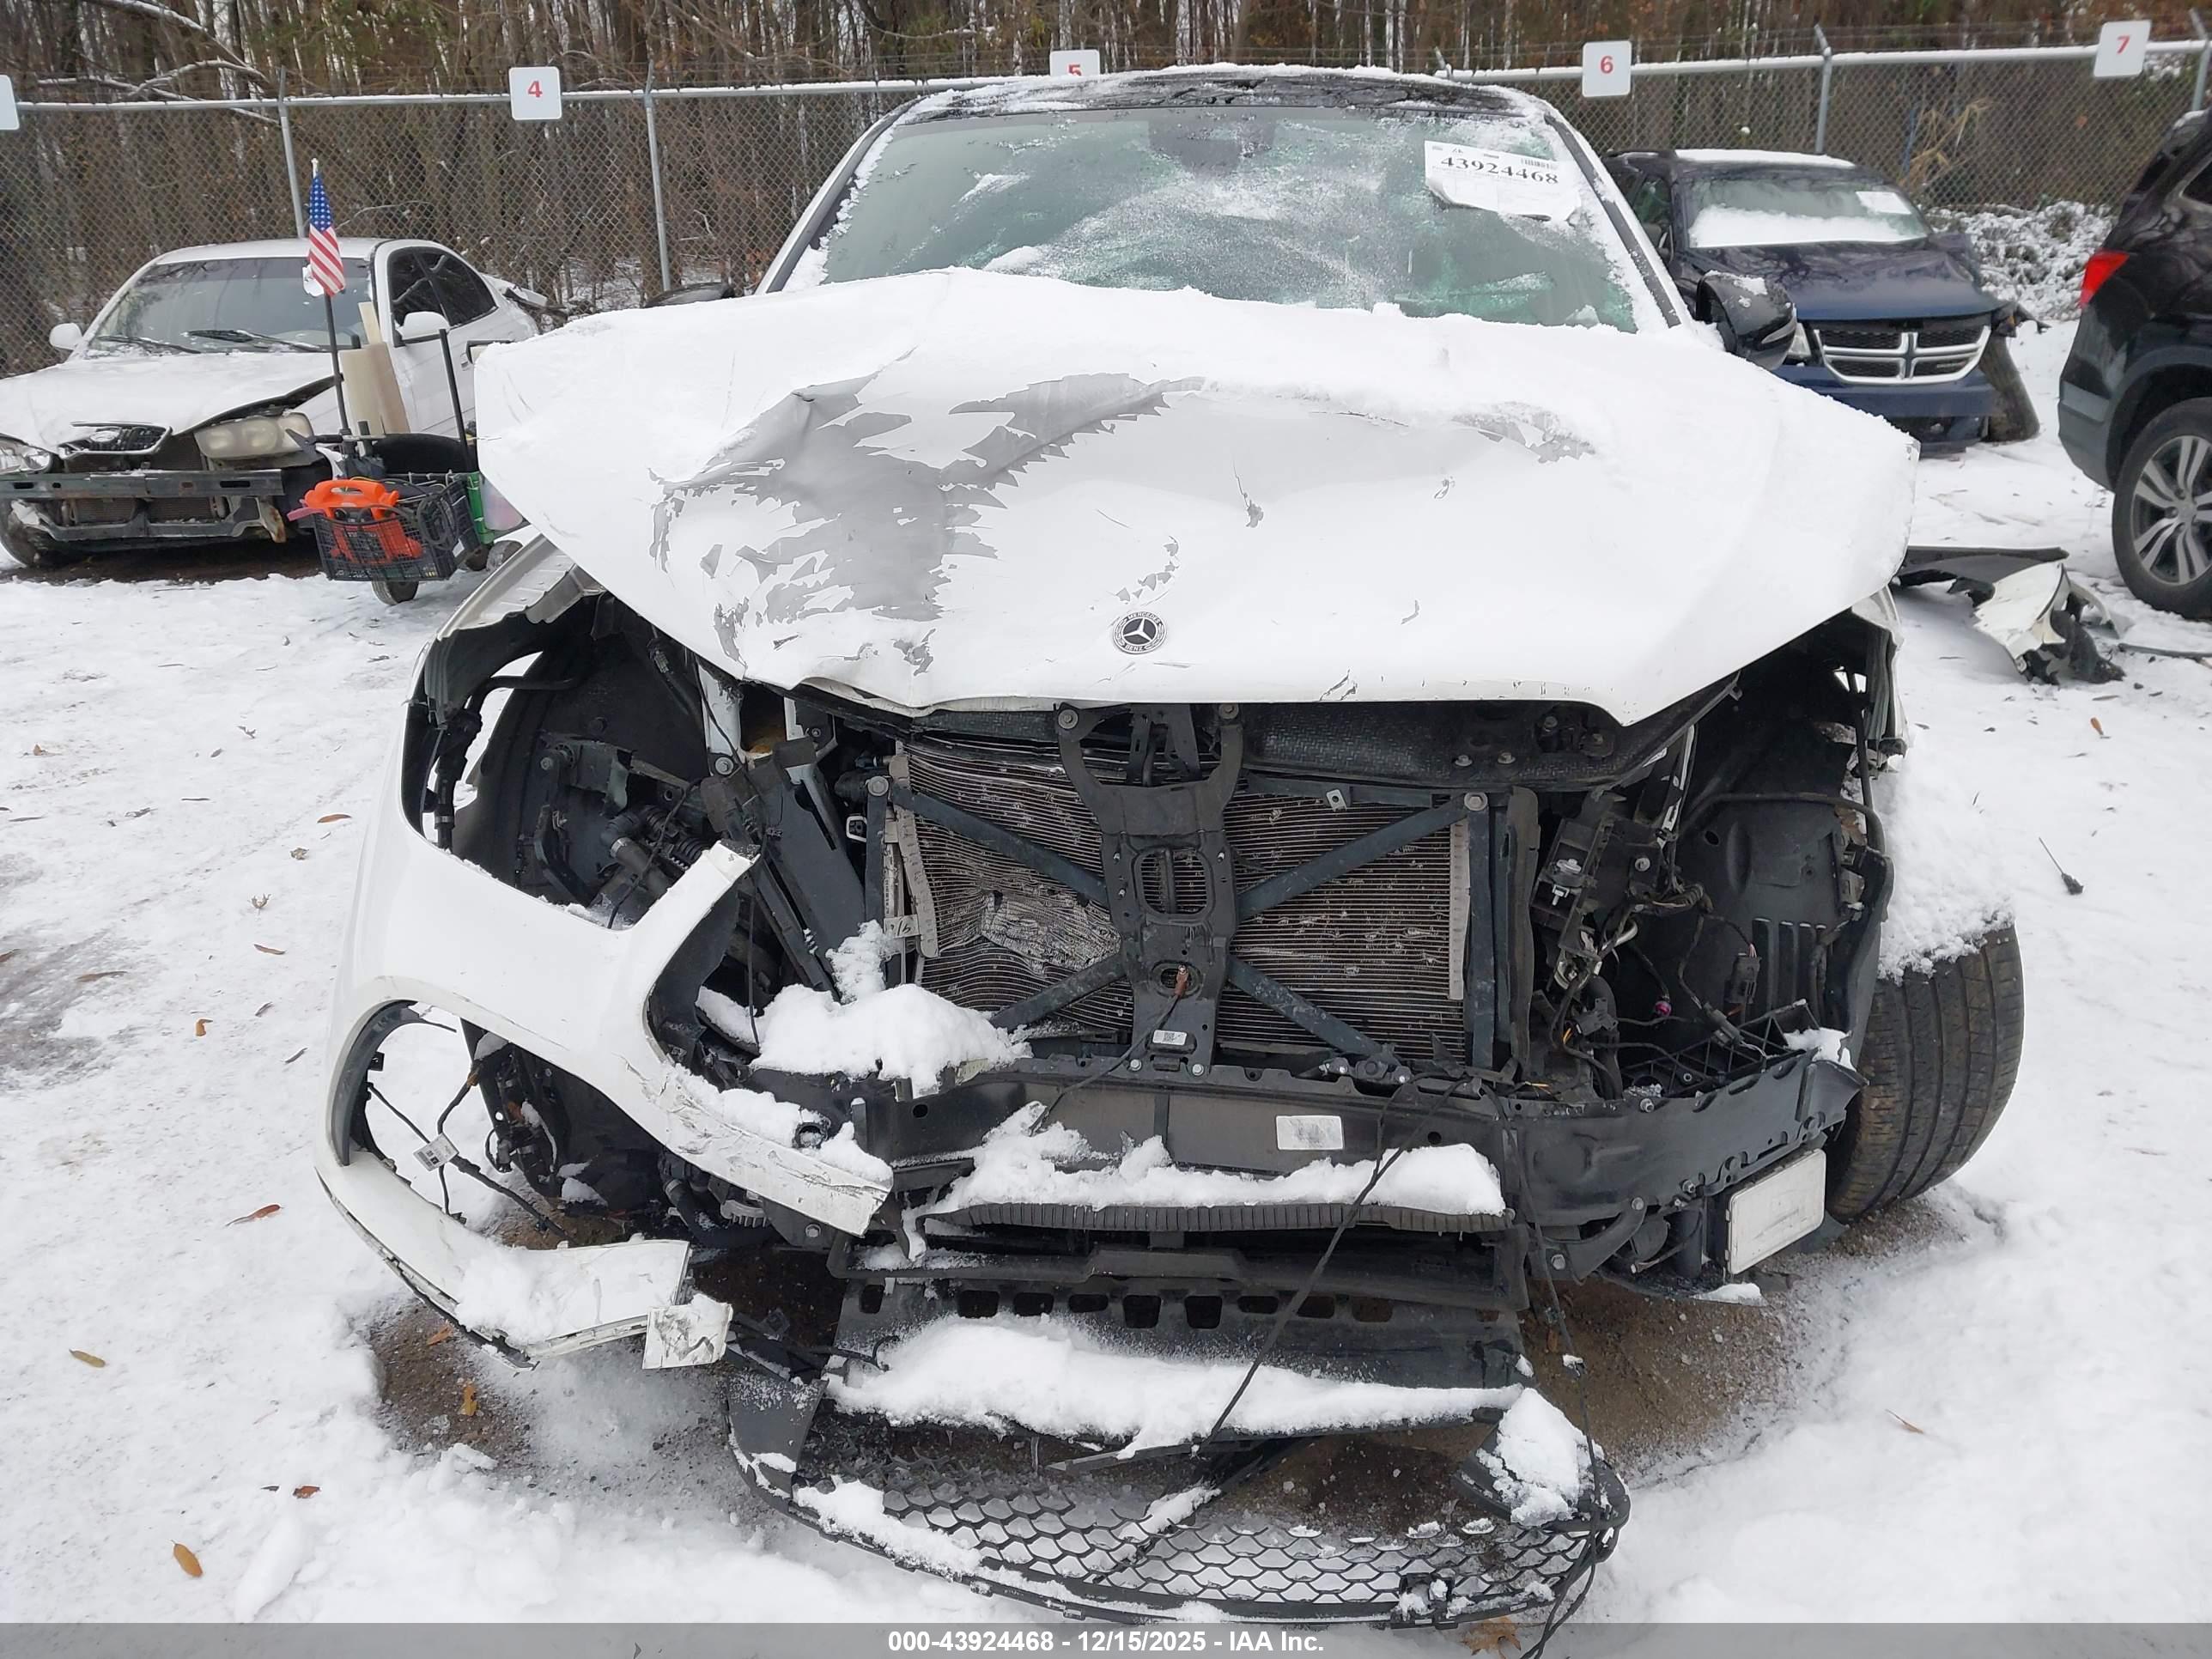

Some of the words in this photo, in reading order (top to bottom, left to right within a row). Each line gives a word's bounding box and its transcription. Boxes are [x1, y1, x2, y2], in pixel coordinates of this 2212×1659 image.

[2117, 35, 2130, 54] 7
[1068, 64, 1082, 76] 5
[1600, 56, 1613, 74] 6
[528, 80, 543, 98] 4
[1440, 156, 1559, 185] 43924468
